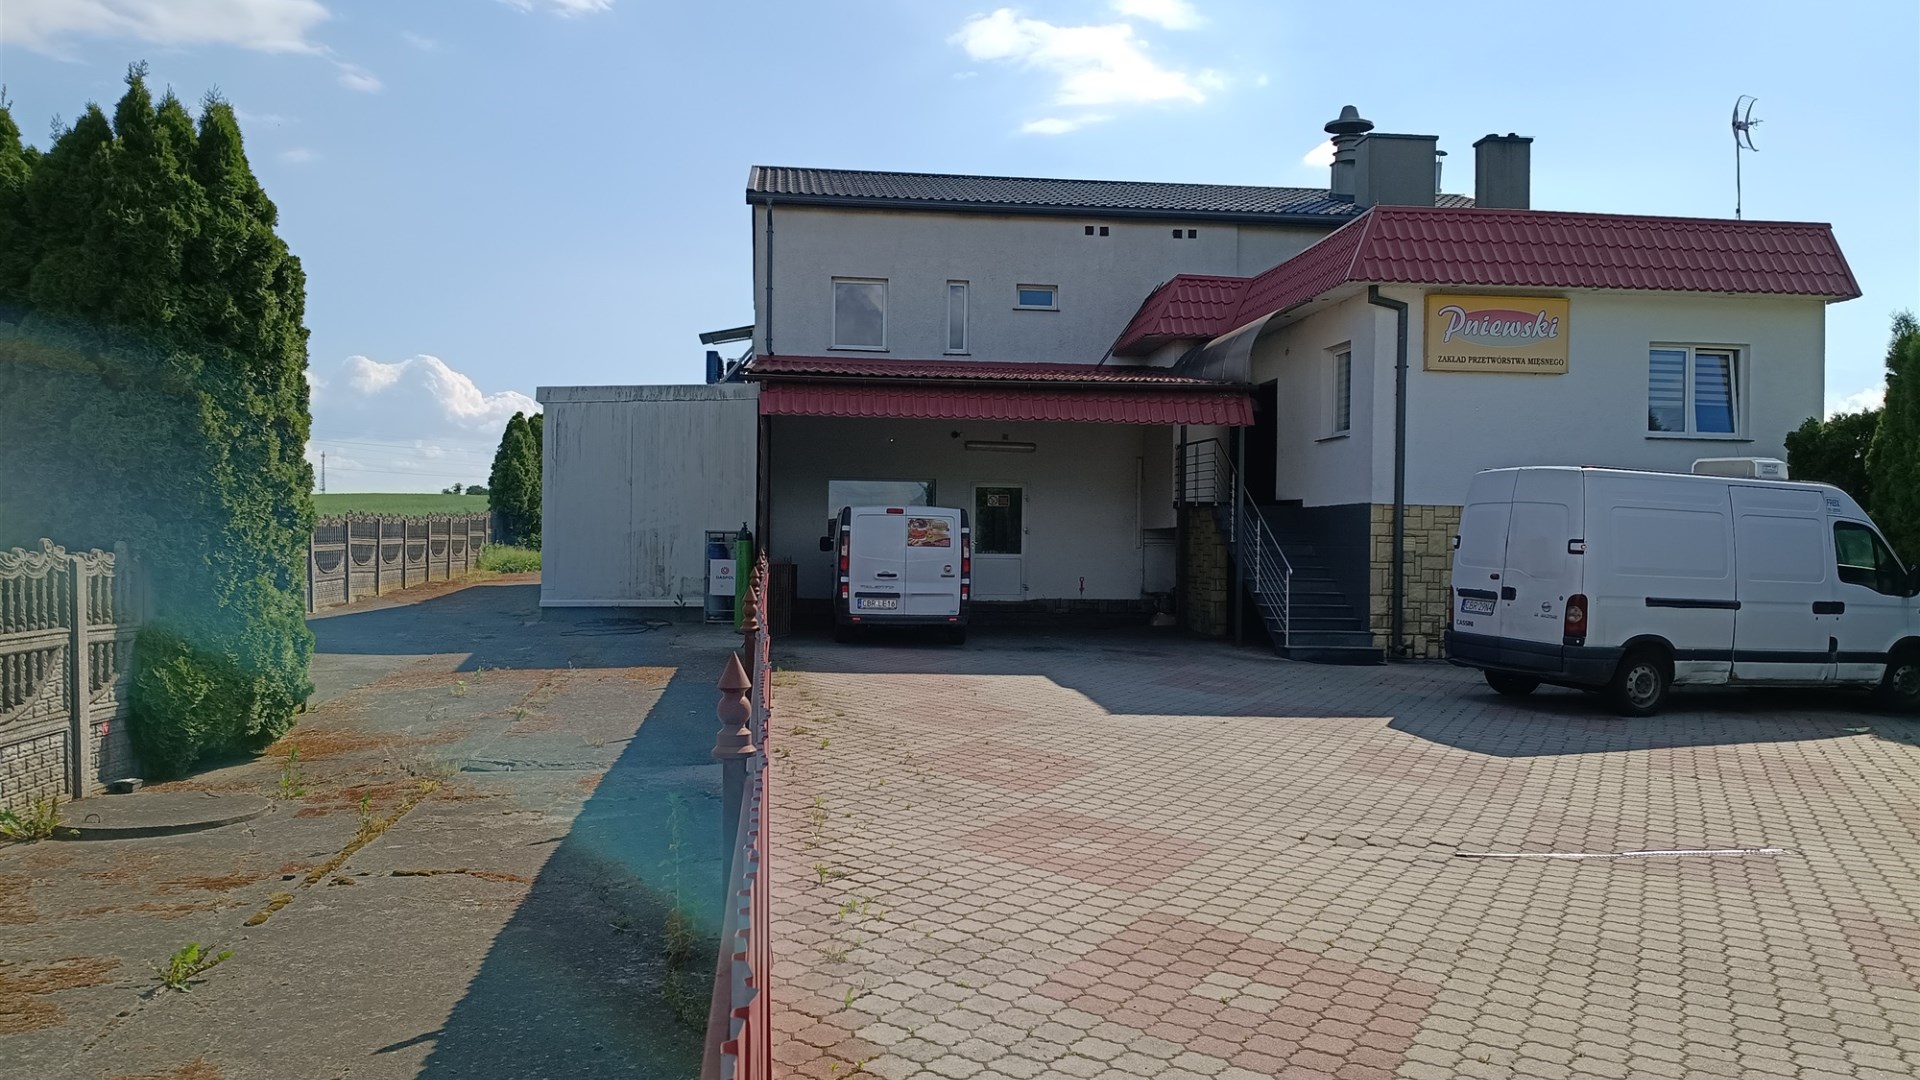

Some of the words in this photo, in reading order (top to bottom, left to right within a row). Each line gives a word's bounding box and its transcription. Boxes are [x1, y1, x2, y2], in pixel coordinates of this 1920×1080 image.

[1438, 305, 1559, 343] Pniewski
[1438, 355, 1466, 364] ZAKŁAD
[1468, 356, 1526, 365] PRZETWÓRSTWA
[1527, 358, 1564, 367] MIĘSNEGO
